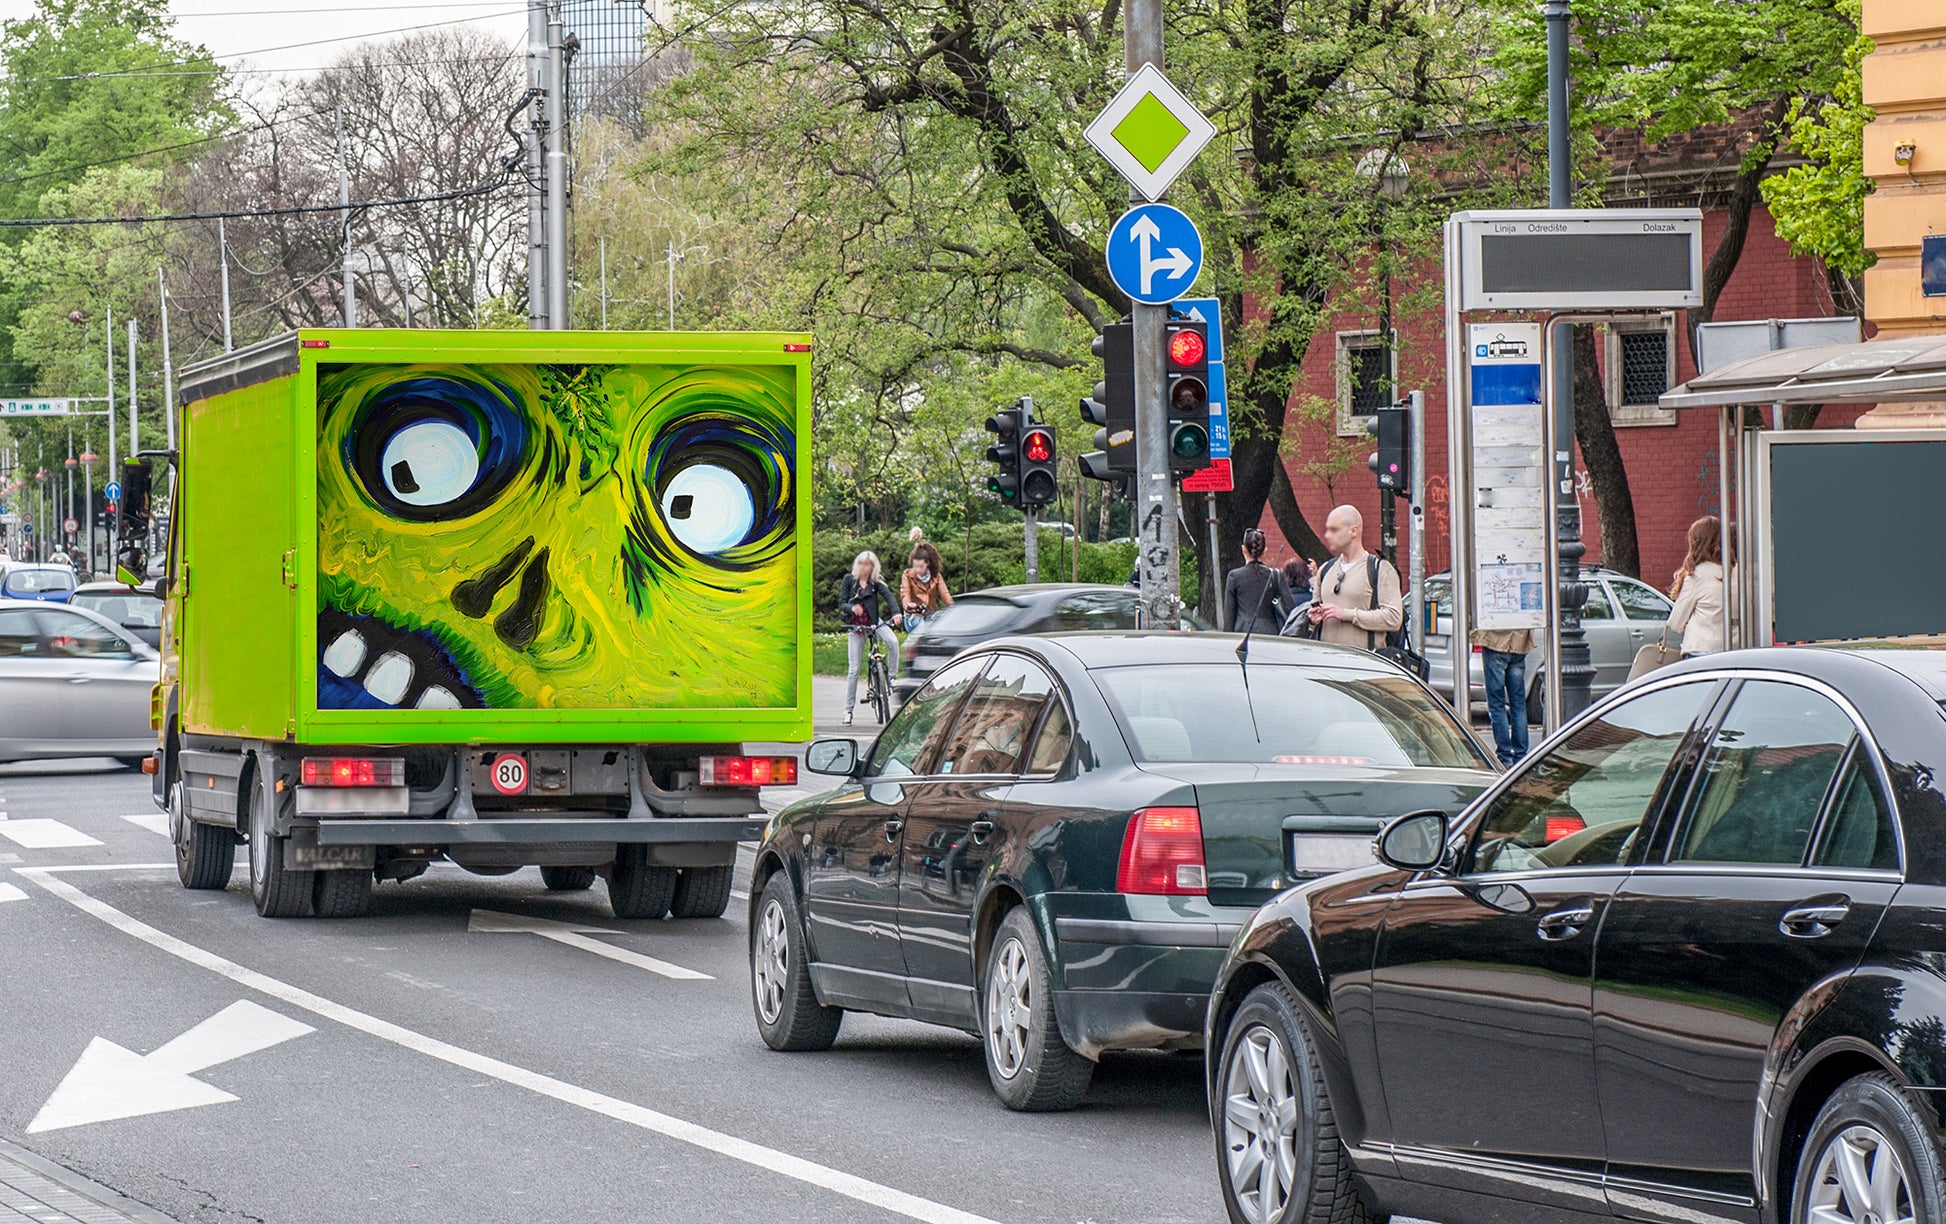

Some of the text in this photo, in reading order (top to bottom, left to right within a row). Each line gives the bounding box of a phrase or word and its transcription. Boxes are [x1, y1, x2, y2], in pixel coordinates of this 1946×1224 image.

[1494, 223, 1676, 234] Linija Odredište Dolazak
[499, 765, 522, 783] 80
